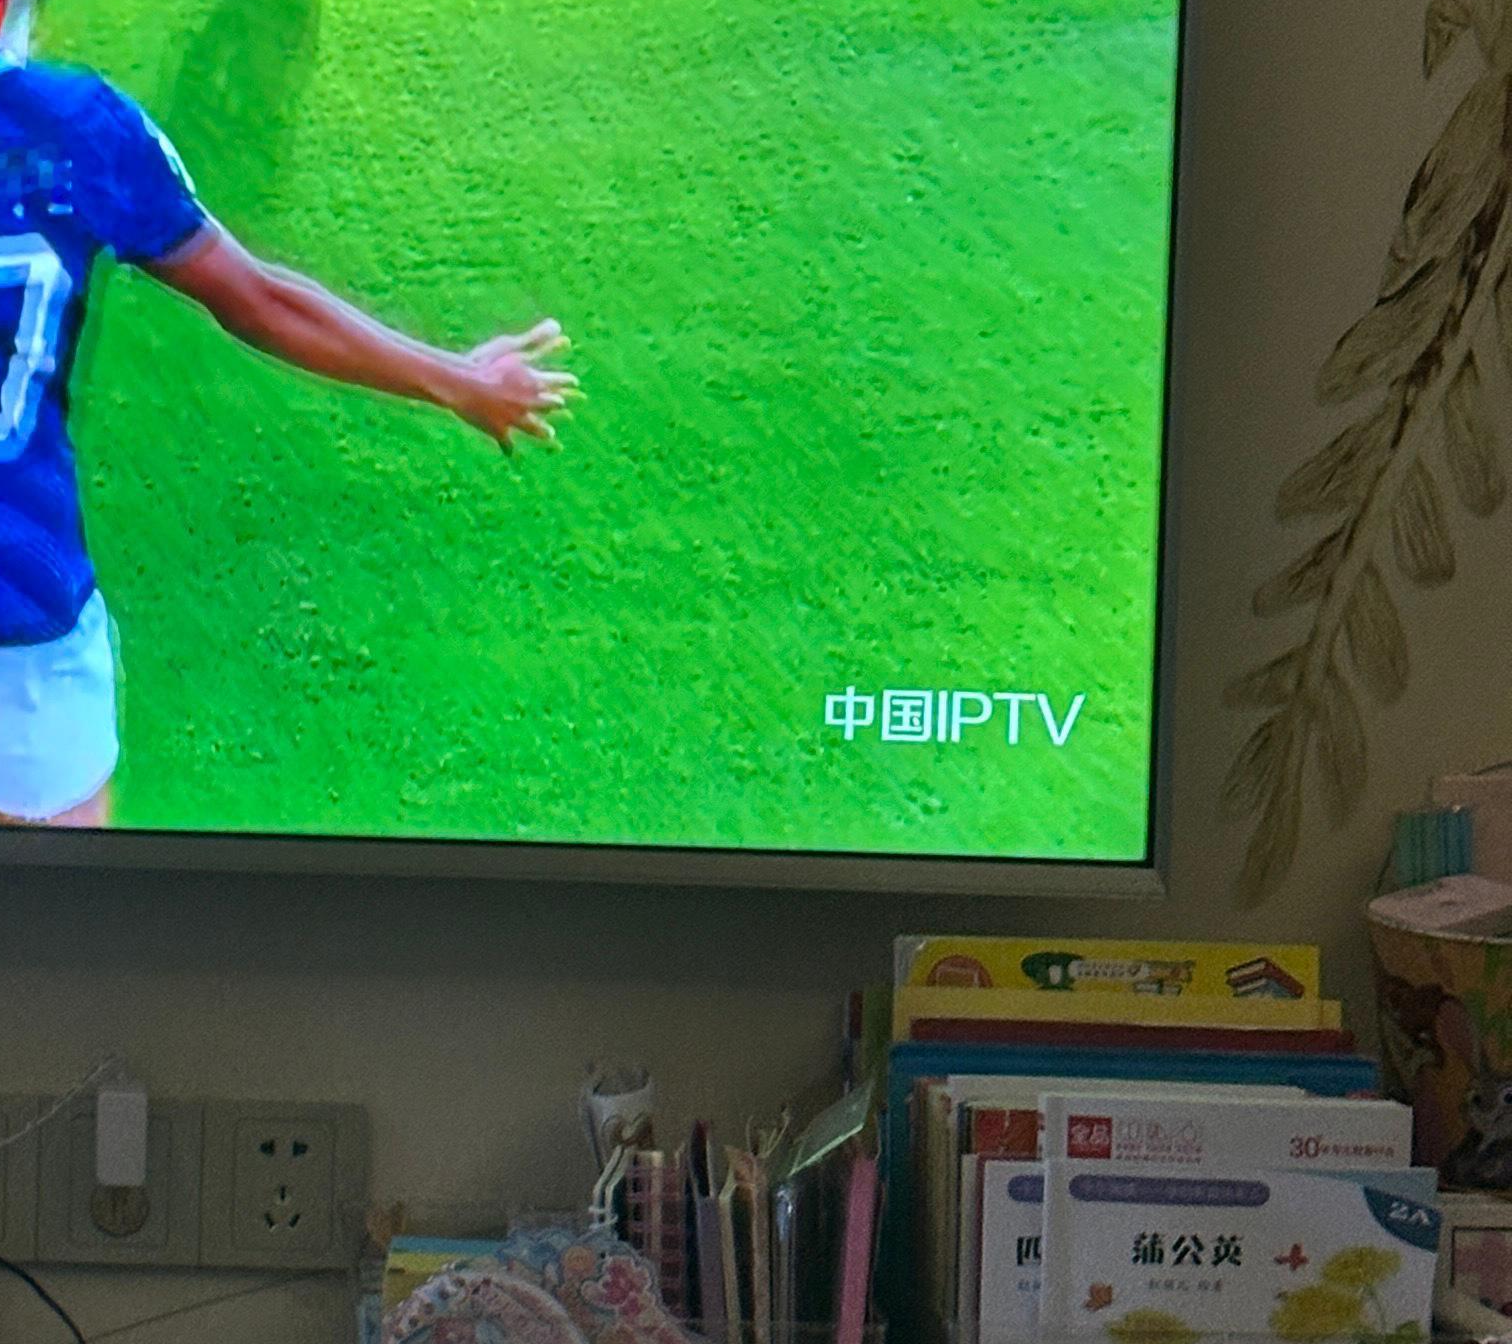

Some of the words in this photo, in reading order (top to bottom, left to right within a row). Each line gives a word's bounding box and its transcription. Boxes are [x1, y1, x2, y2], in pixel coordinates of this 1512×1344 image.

[824, 686, 1086, 747] 中国IPTV
[1131, 1231, 1244, 1267] 蒲公英
